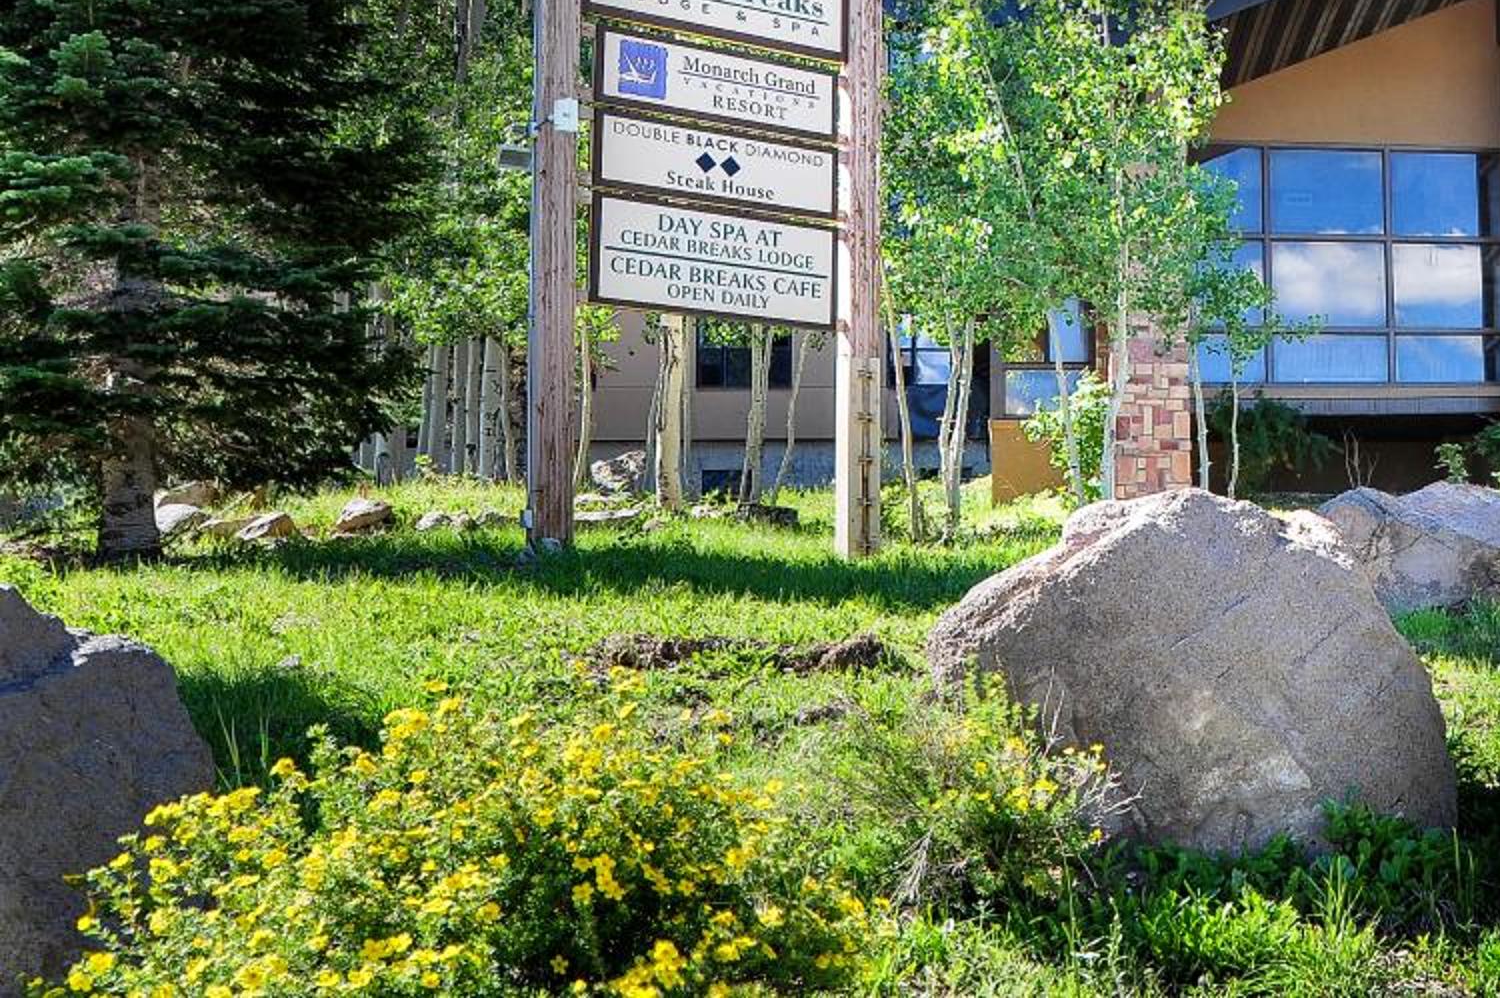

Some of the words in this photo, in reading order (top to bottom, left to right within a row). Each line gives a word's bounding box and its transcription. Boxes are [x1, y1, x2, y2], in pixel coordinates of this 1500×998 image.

[773, 19, 820, 36] SPA
[682, 55, 760, 85] Monarch
[765, 73, 816, 95] Grand
[683, 78, 816, 109] VACATIONS
[713, 95, 788, 121] RESORT
[613, 121, 681, 145] DOUBLE
[686, 133, 738, 153] BLACK
[745, 143, 824, 168] DIAMOND
[667, 170, 716, 192] Steak
[722, 179, 775, 201] House
[658, 214, 703, 237] DAY
[710, 222, 748, 243] SPA
[756, 229, 782, 248] AT
[621, 229, 680, 251] CEDAR
[687, 240, 753, 261] BREAKS
[759, 250, 815, 271] LODGE
[611, 256, 682, 282] CEDAR
[689, 266, 767, 292] BREAKS
[773, 277, 822, 299] CAFE
[667, 283, 715, 303] OPEN
[722, 290, 770, 310] DAILY
